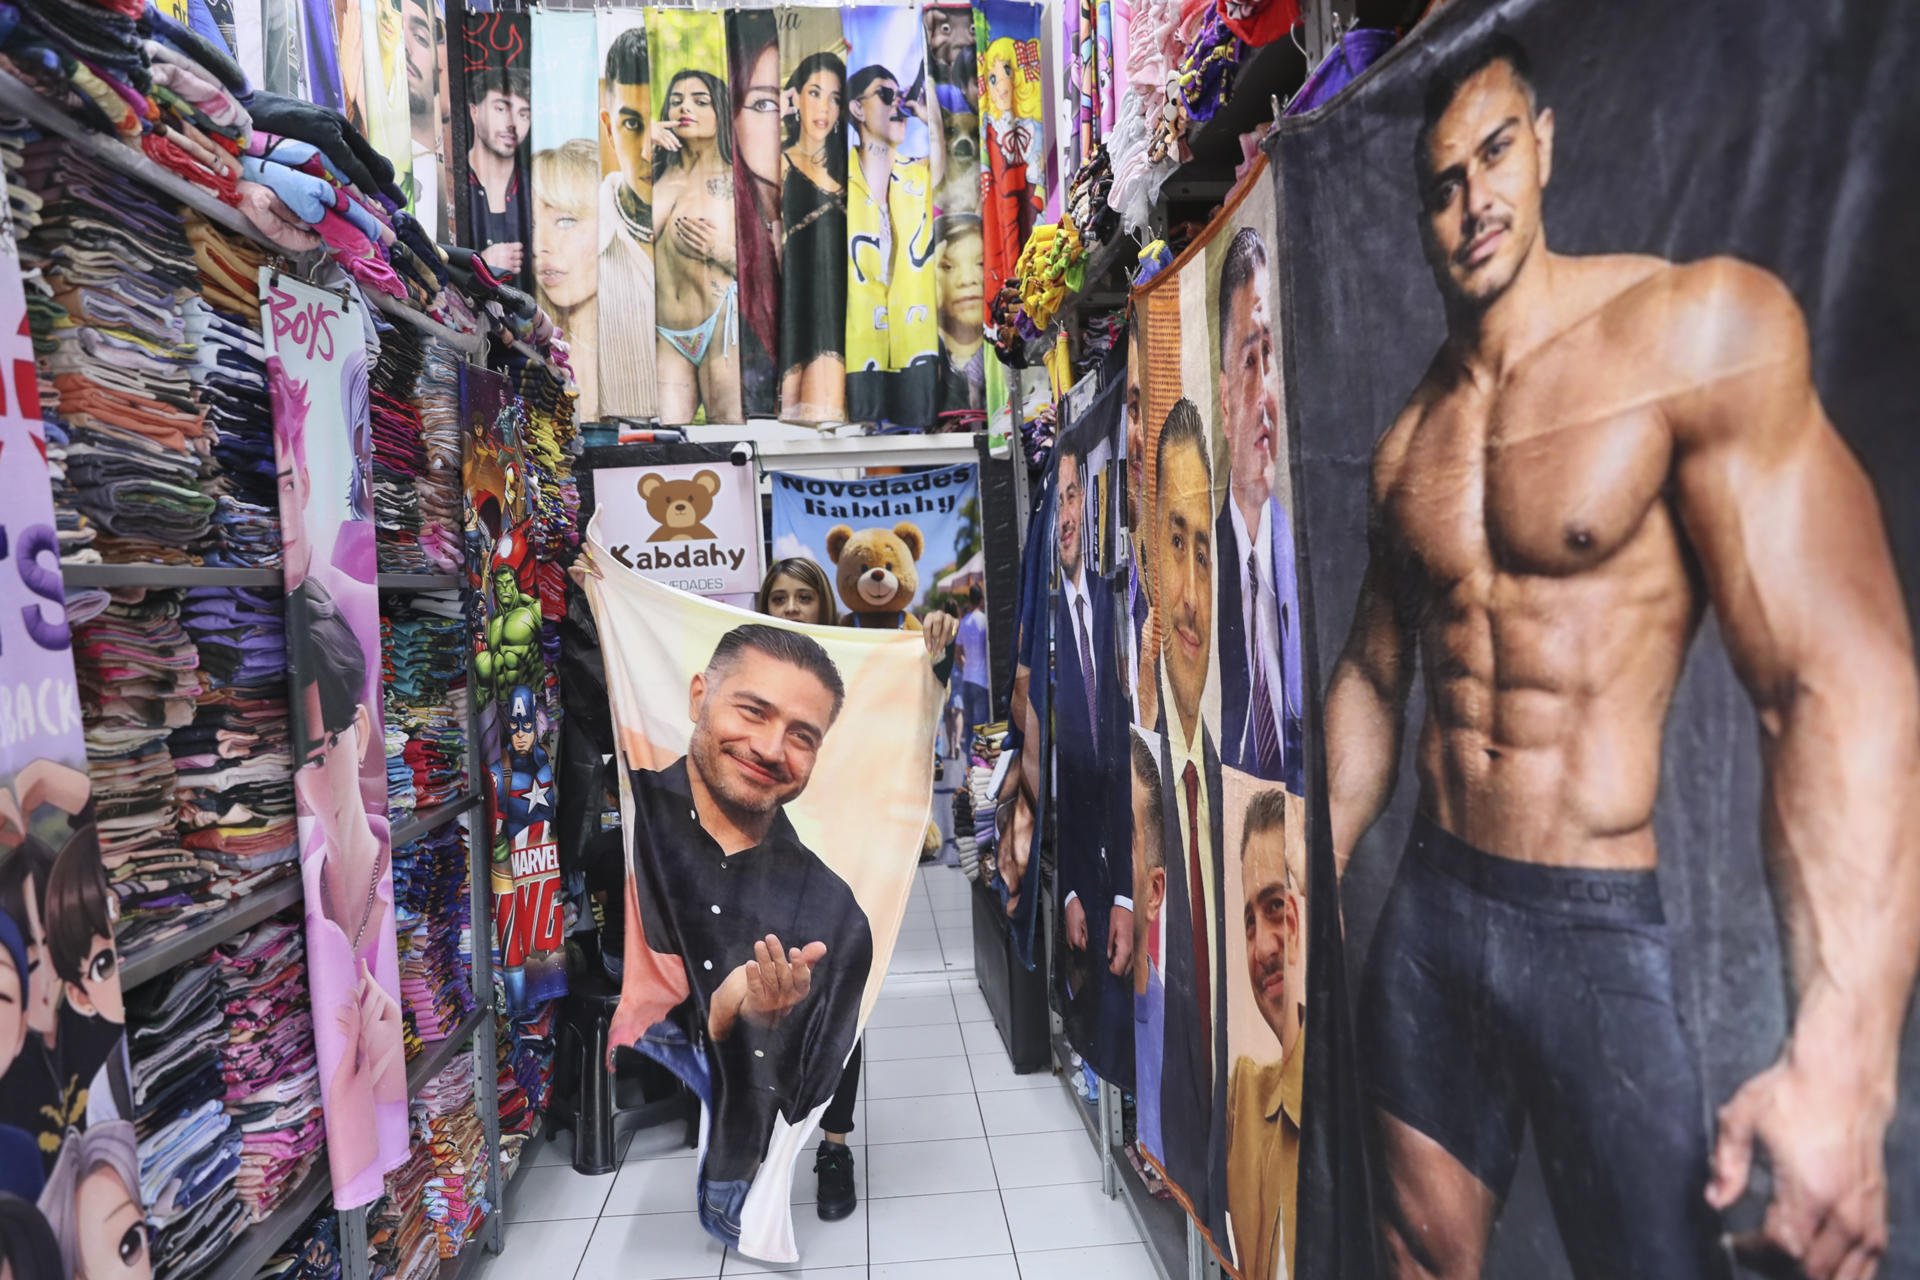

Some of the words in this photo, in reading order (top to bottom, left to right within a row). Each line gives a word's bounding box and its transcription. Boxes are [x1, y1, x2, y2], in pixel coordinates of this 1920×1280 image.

[780, 467, 970, 498] Novedades
[804, 495, 956, 518] Kabdahy
[610, 542, 745, 571] Kabdahy
[660, 577, 724, 591] EDADES
[511, 844, 560, 879] MARVEL
